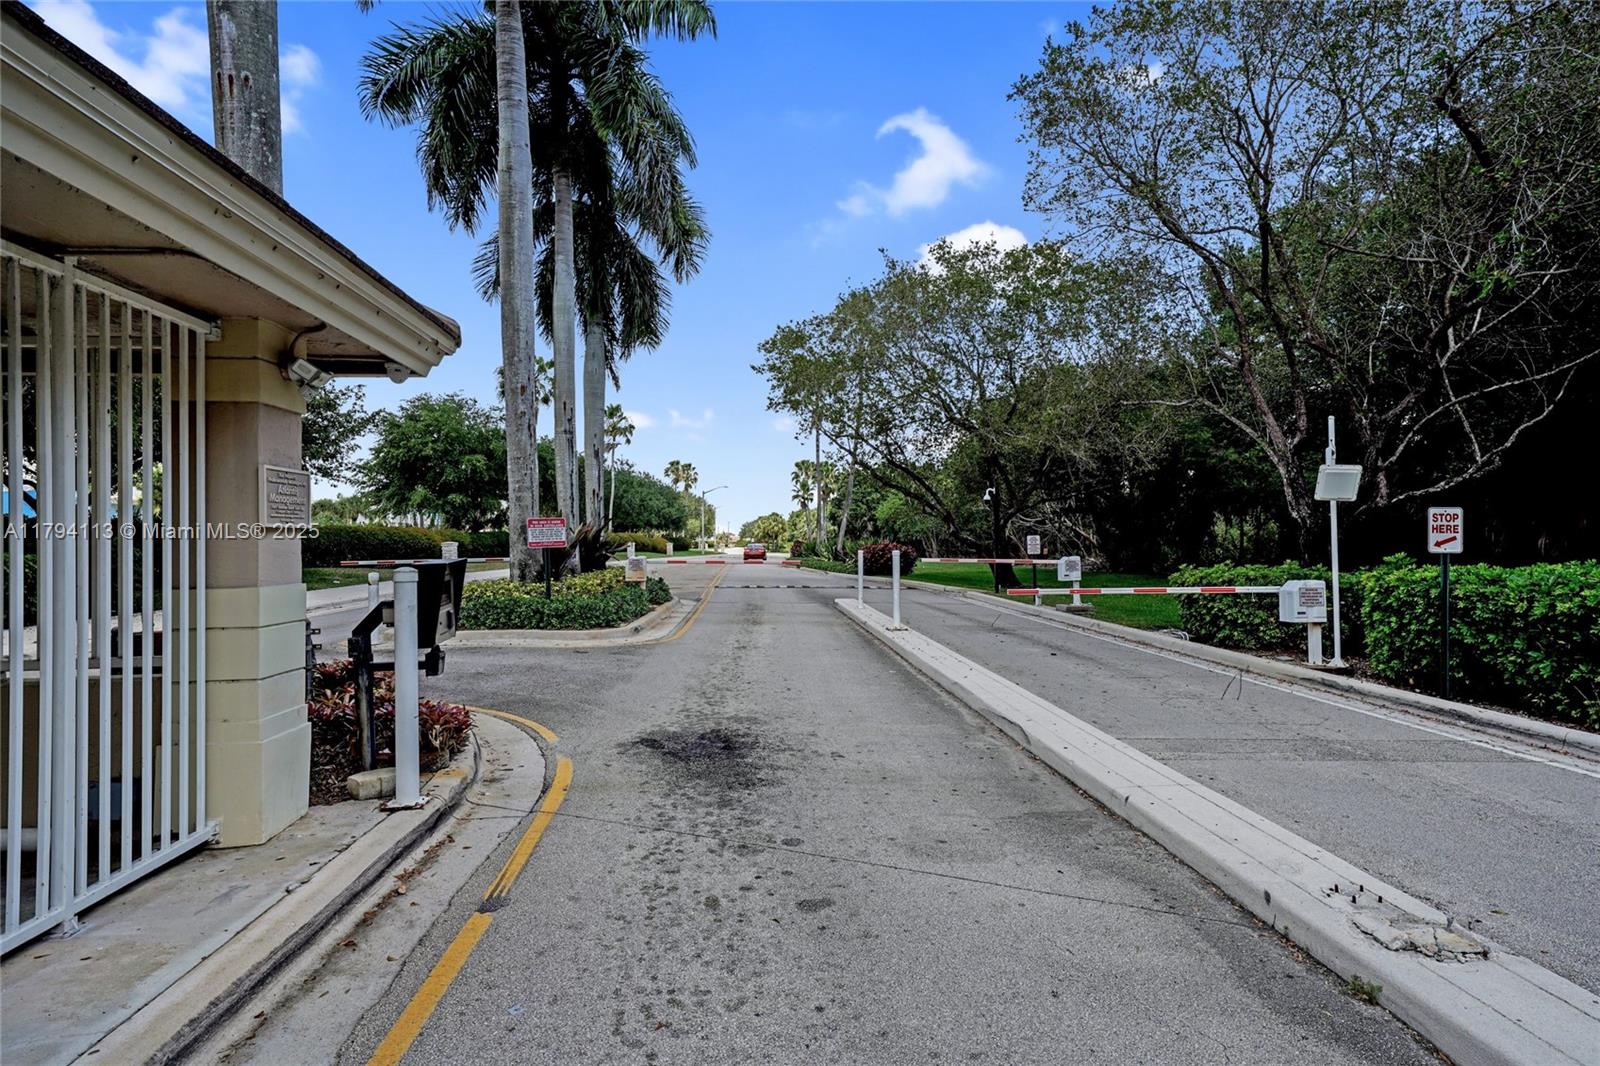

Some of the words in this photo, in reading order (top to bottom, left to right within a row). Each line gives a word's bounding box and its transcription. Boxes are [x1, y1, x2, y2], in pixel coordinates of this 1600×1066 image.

[270, 493, 306, 505] Management
[1432, 513, 1459, 523] STOP
[1432, 524, 1459, 534] HERE
